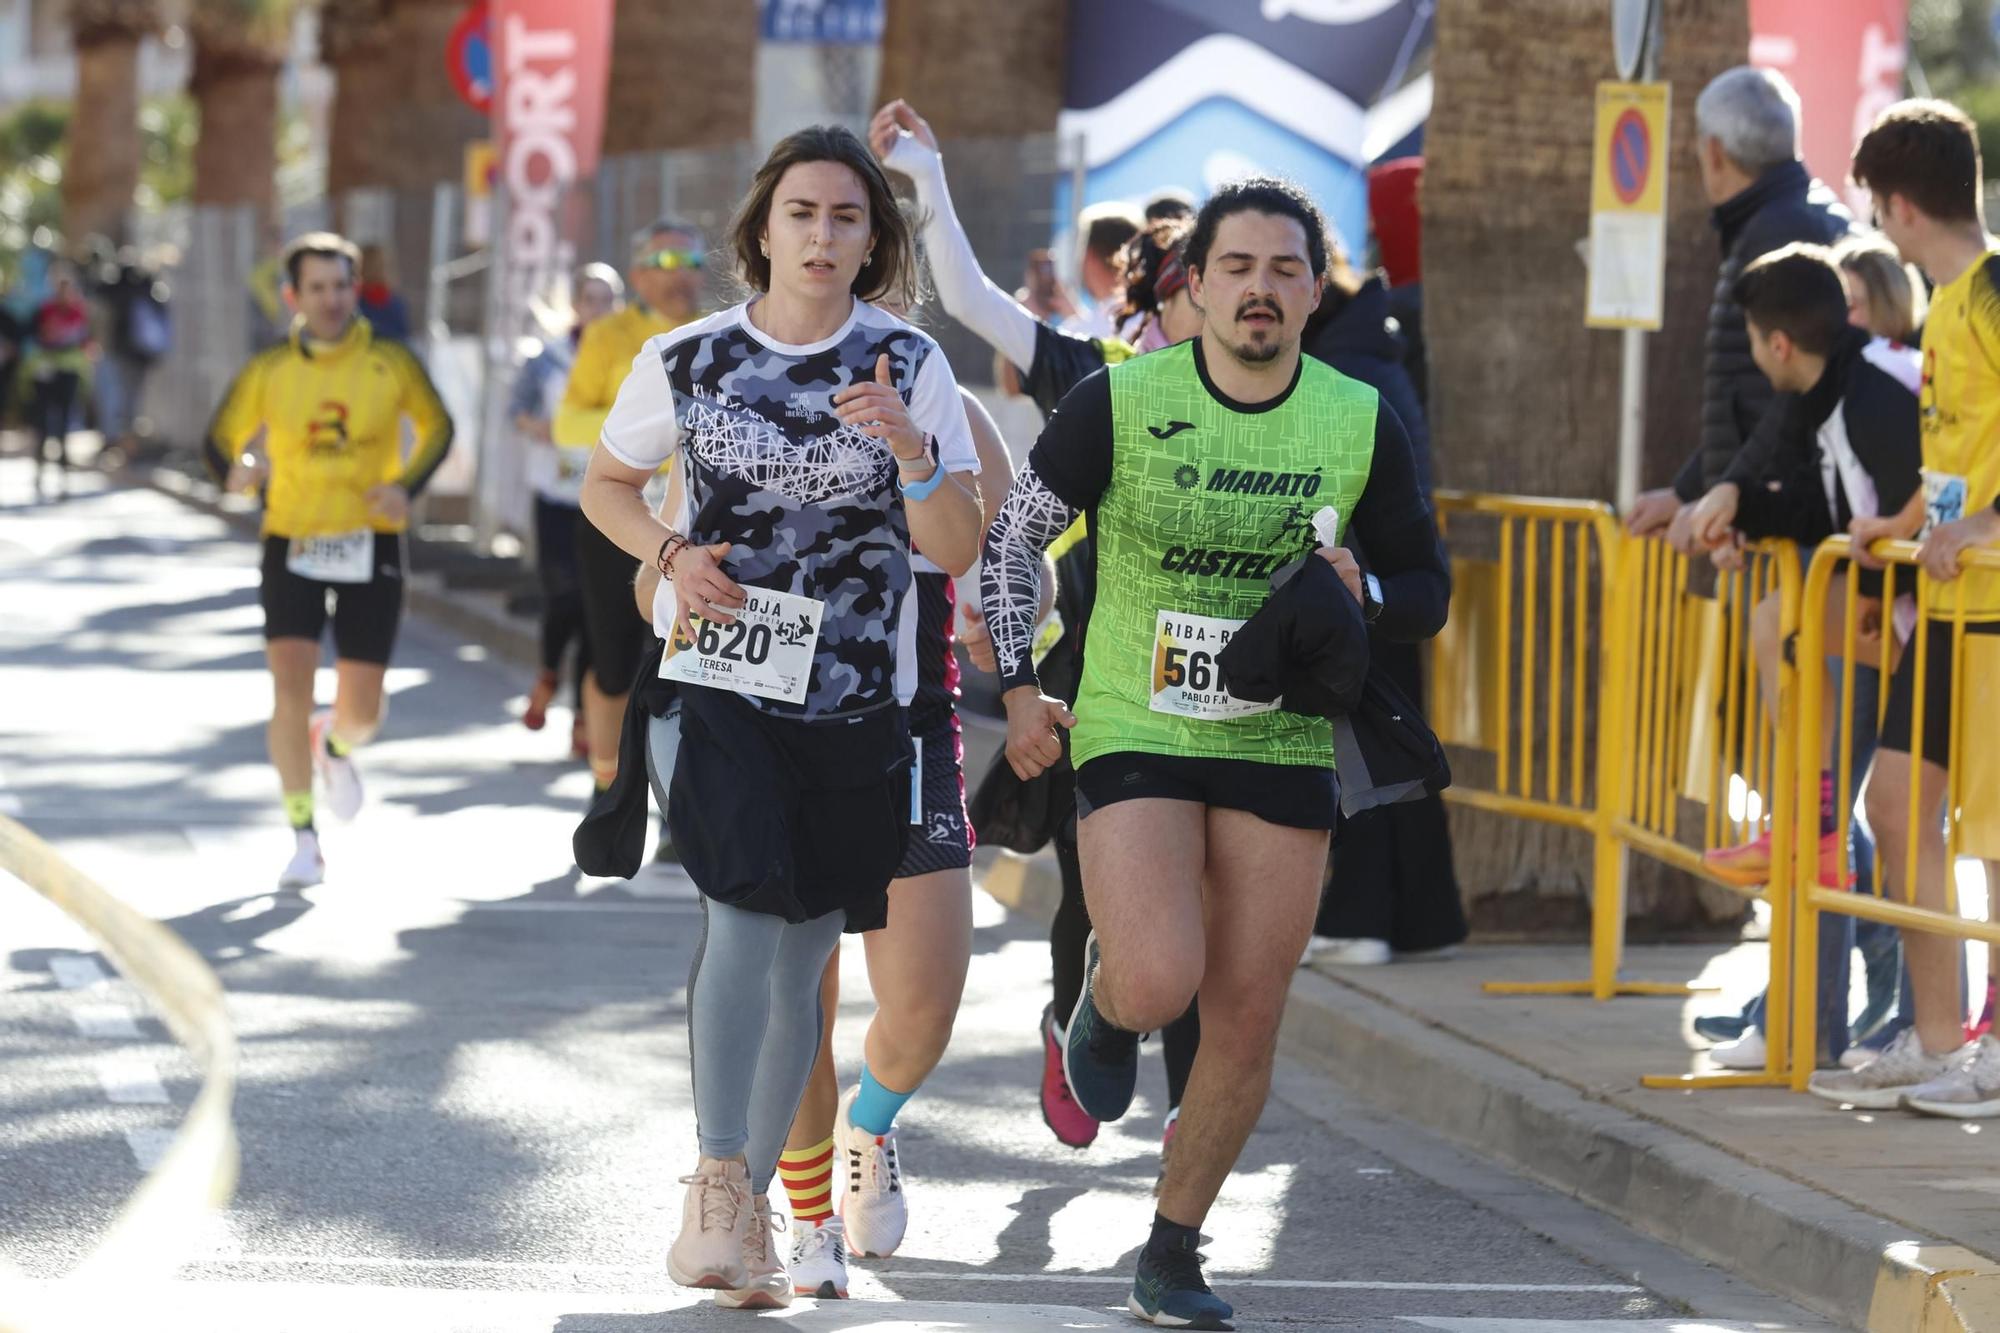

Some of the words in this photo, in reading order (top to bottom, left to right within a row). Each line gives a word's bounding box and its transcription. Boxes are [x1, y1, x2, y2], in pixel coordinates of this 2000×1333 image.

[806, 413, 822, 424] 2017
[1206, 466, 1323, 498] MARATÓ
[674, 611, 772, 665] 5620
[698, 657, 733, 673] TERESA
[1181, 691, 1210, 704] PABLO
